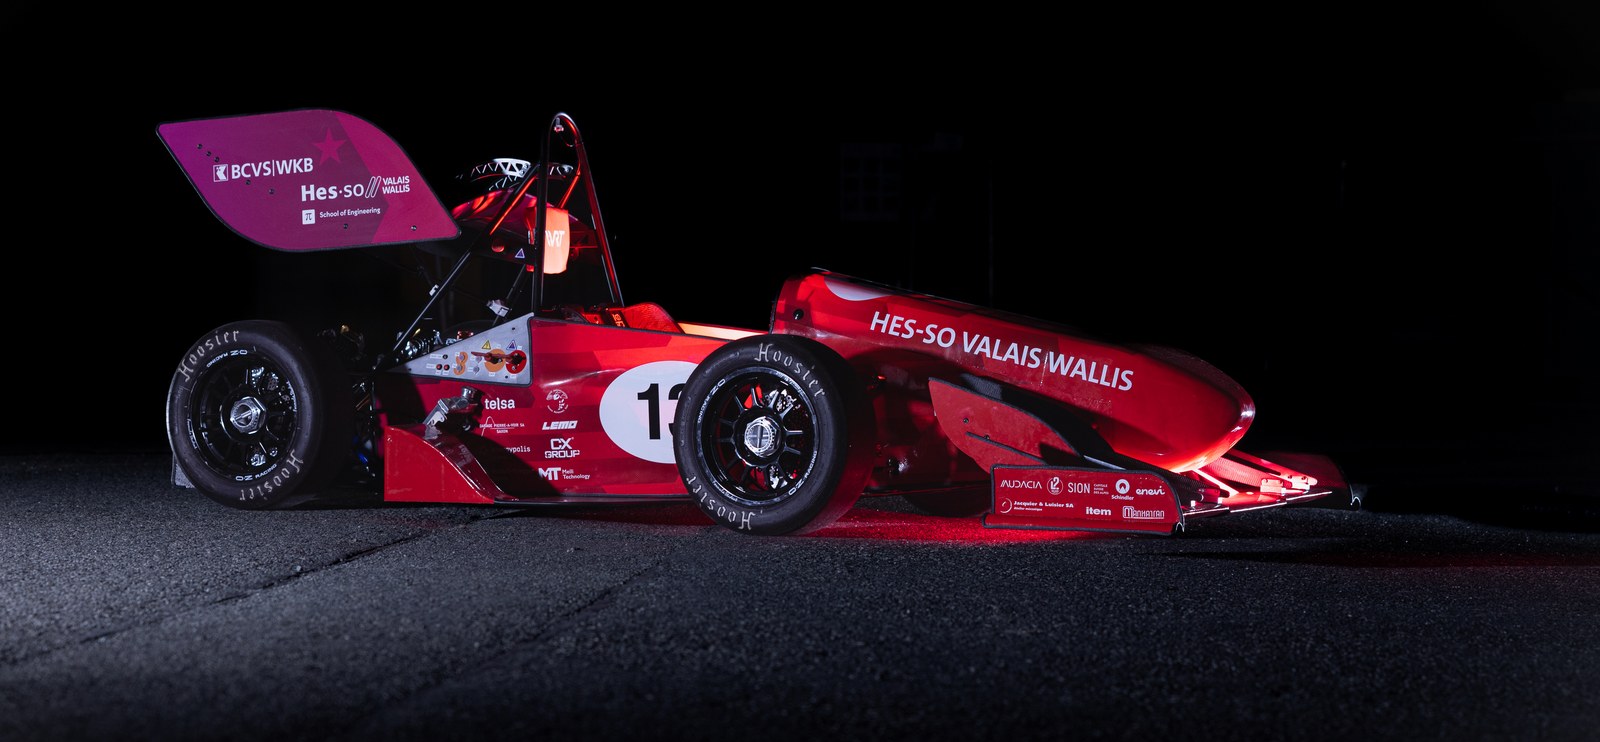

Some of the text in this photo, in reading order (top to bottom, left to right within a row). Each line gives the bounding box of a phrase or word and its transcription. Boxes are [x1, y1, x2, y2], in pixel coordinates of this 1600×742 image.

[382, 176, 410, 185] VALAIS
[382, 185, 410, 194] WALLIS
[320, 210, 339, 218] School
[347, 207, 381, 217] Engineering
[177, 330, 240, 382] Hoosier
[870, 311, 1134, 391] HES-SO VALAIS WALLIS
[754, 343, 826, 397] Hoosier
[484, 397, 515, 411] telsa
[542, 420, 578, 431] LEMO
[550, 437, 573, 450] CX
[544, 449, 580, 459] GROUP
[240, 449, 303, 501] Hoosier
[254, 463, 277, 479] RACING
[1000, 480, 1043, 489] AUDACIA
[1068, 482, 1091, 494] SION
[1135, 486, 1166, 496] enevi
[686, 476, 756, 531] Hoosier
[1085, 507, 1112, 516] item
